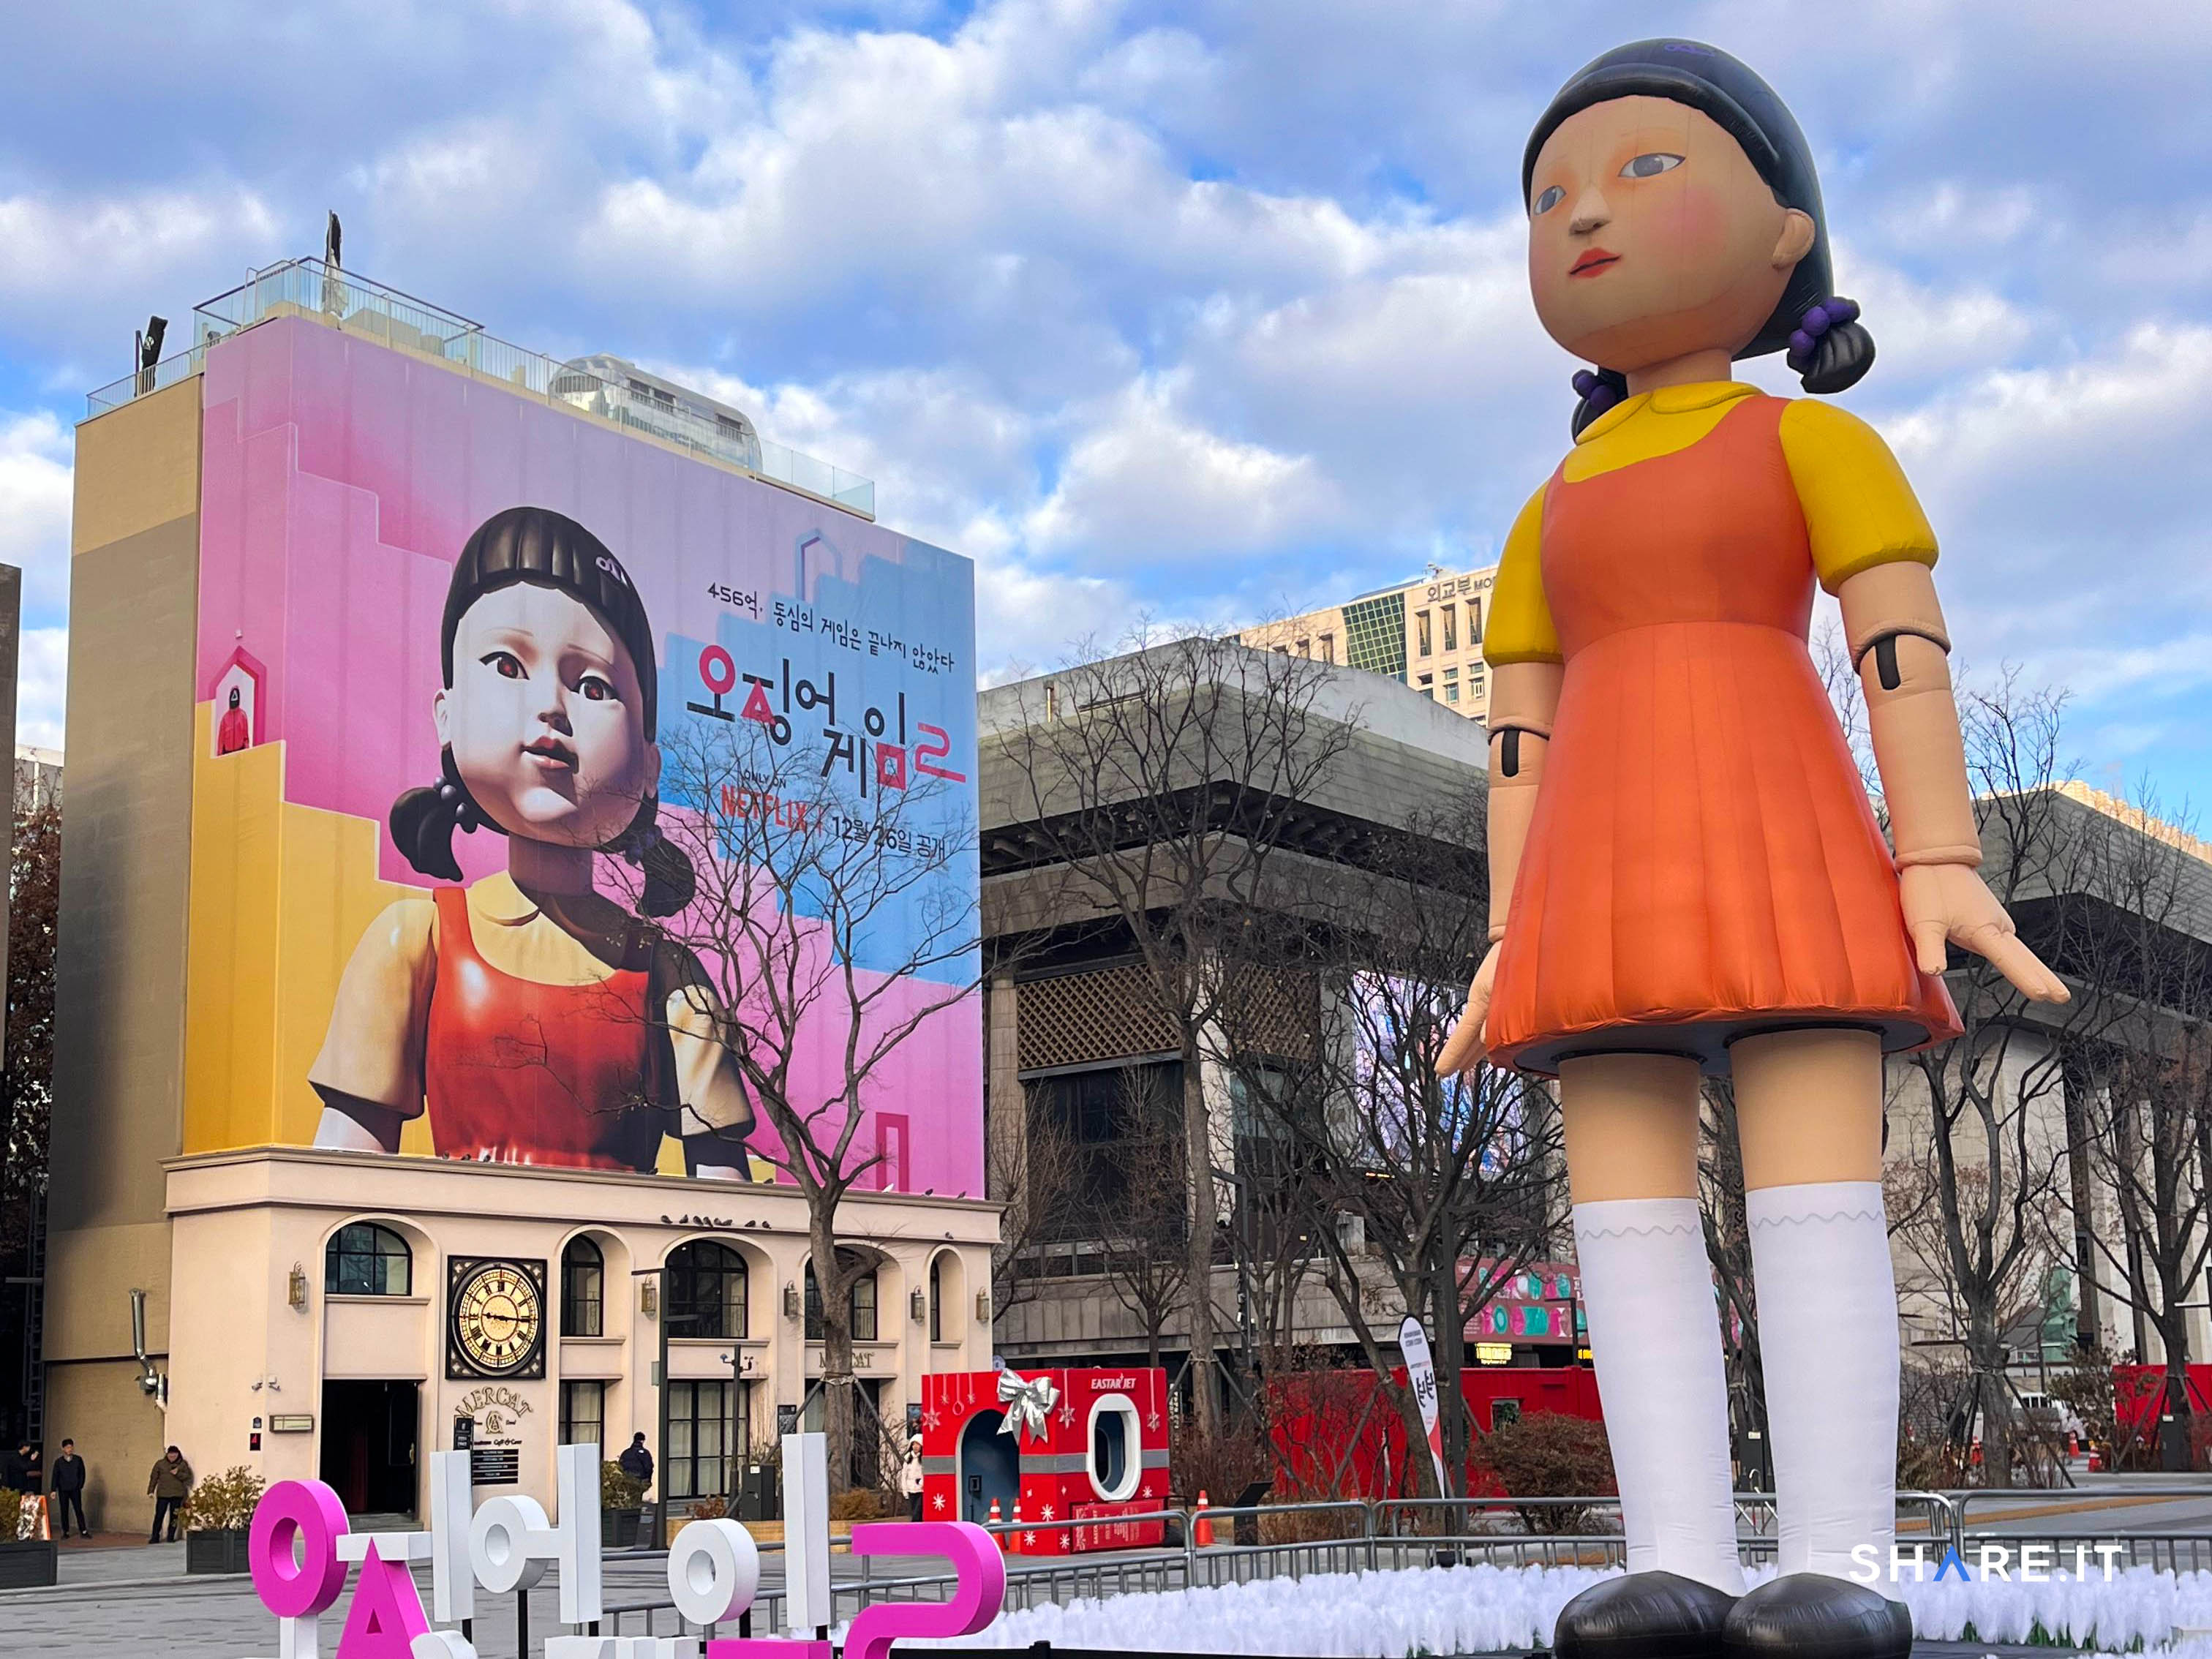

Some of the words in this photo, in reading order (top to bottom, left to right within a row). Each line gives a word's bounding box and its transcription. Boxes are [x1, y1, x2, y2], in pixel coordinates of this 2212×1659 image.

[1427, 577, 1471, 601] 외교부
[1474, 575, 1497, 591] MO
[773, 602, 813, 632] 동심의
[821, 617, 862, 650] 게임은
[868, 631, 906, 658] 끝나지
[912, 647, 955, 674] 않았다
[687, 644, 835, 745] 오징어
[772, 777, 786, 789] ON
[721, 784, 808, 833] NETFLIX
[832, 816, 869, 844] 12월
[917, 835, 945, 861] 공개
[455, 1386, 533, 1418] MERCAT
